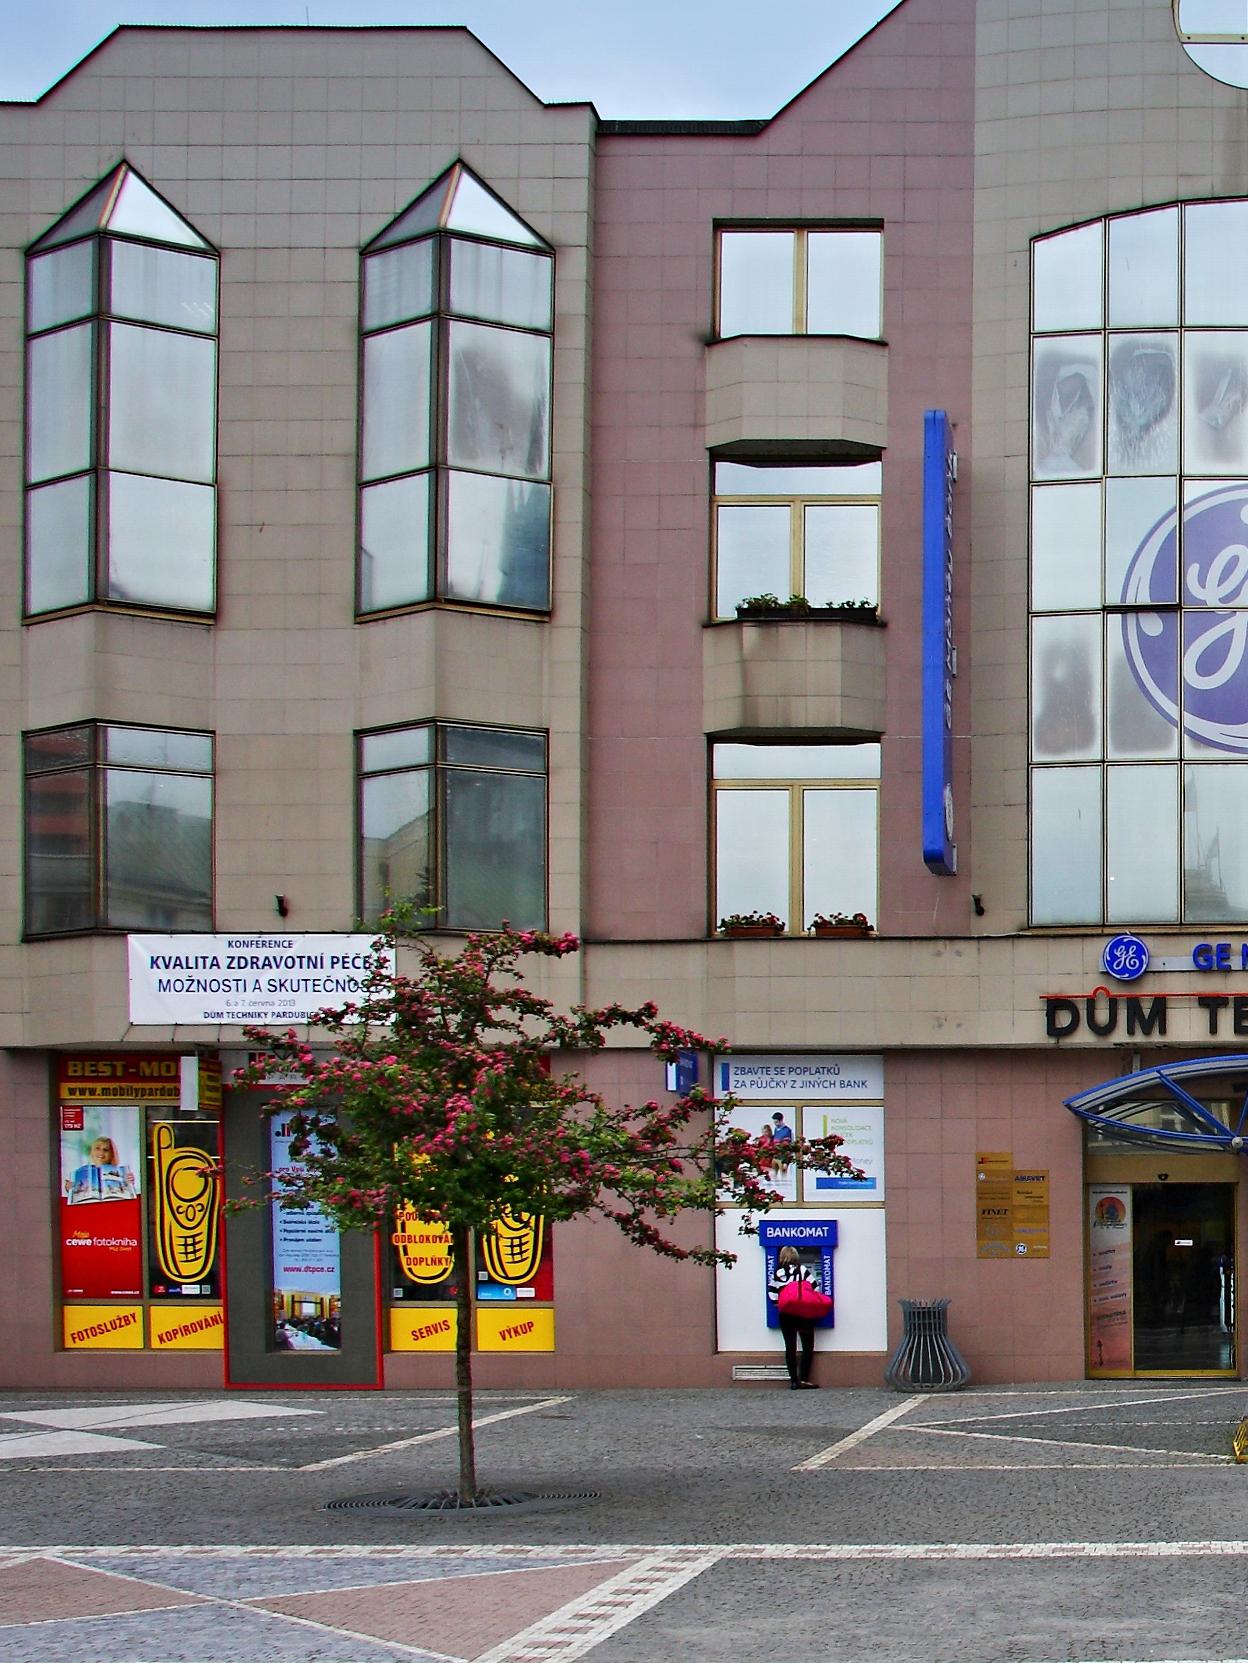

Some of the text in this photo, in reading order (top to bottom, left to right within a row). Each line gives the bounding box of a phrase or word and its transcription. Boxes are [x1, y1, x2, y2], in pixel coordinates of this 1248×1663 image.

[227, 940, 294, 949] KONFERENCE
[150, 955, 221, 970] KVALITA
[226, 953, 324, 970] ZDRAVOTNÍ
[1192, 943, 1232, 972] GE
[158, 976, 382, 993] MOŽNOSTI A SKUTEČNOS
[277, 999, 296, 1007] 2013
[226, 1011, 268, 1019] TECHNIKY
[1045, 987, 1168, 1037] DŮM
[733, 1063, 841, 1076] ZBAVTE SE POPLATKŮ
[733, 1076, 868, 1089] ZA PŮJČKY Z JINÝCH BANK
[68, 1085, 181, 1098] www.mobilypardub
[766, 1226, 829, 1238] BANKOMAT
[93, 1236, 138, 1246] fotokniha
[406, 1255, 451, 1266] DOPLŇKY
[283, 1265, 335, 1274] www.dtpce.cz
[823, 1255, 832, 1296] BANKOMAT
[70, 1312, 137, 1344] FOTOSLUŽBY
[157, 1311, 224, 1345] KOPÍROVÁNÍ
[411, 1319, 450, 1341] SERVIS
[499, 1321, 534, 1341] VÝKUP
